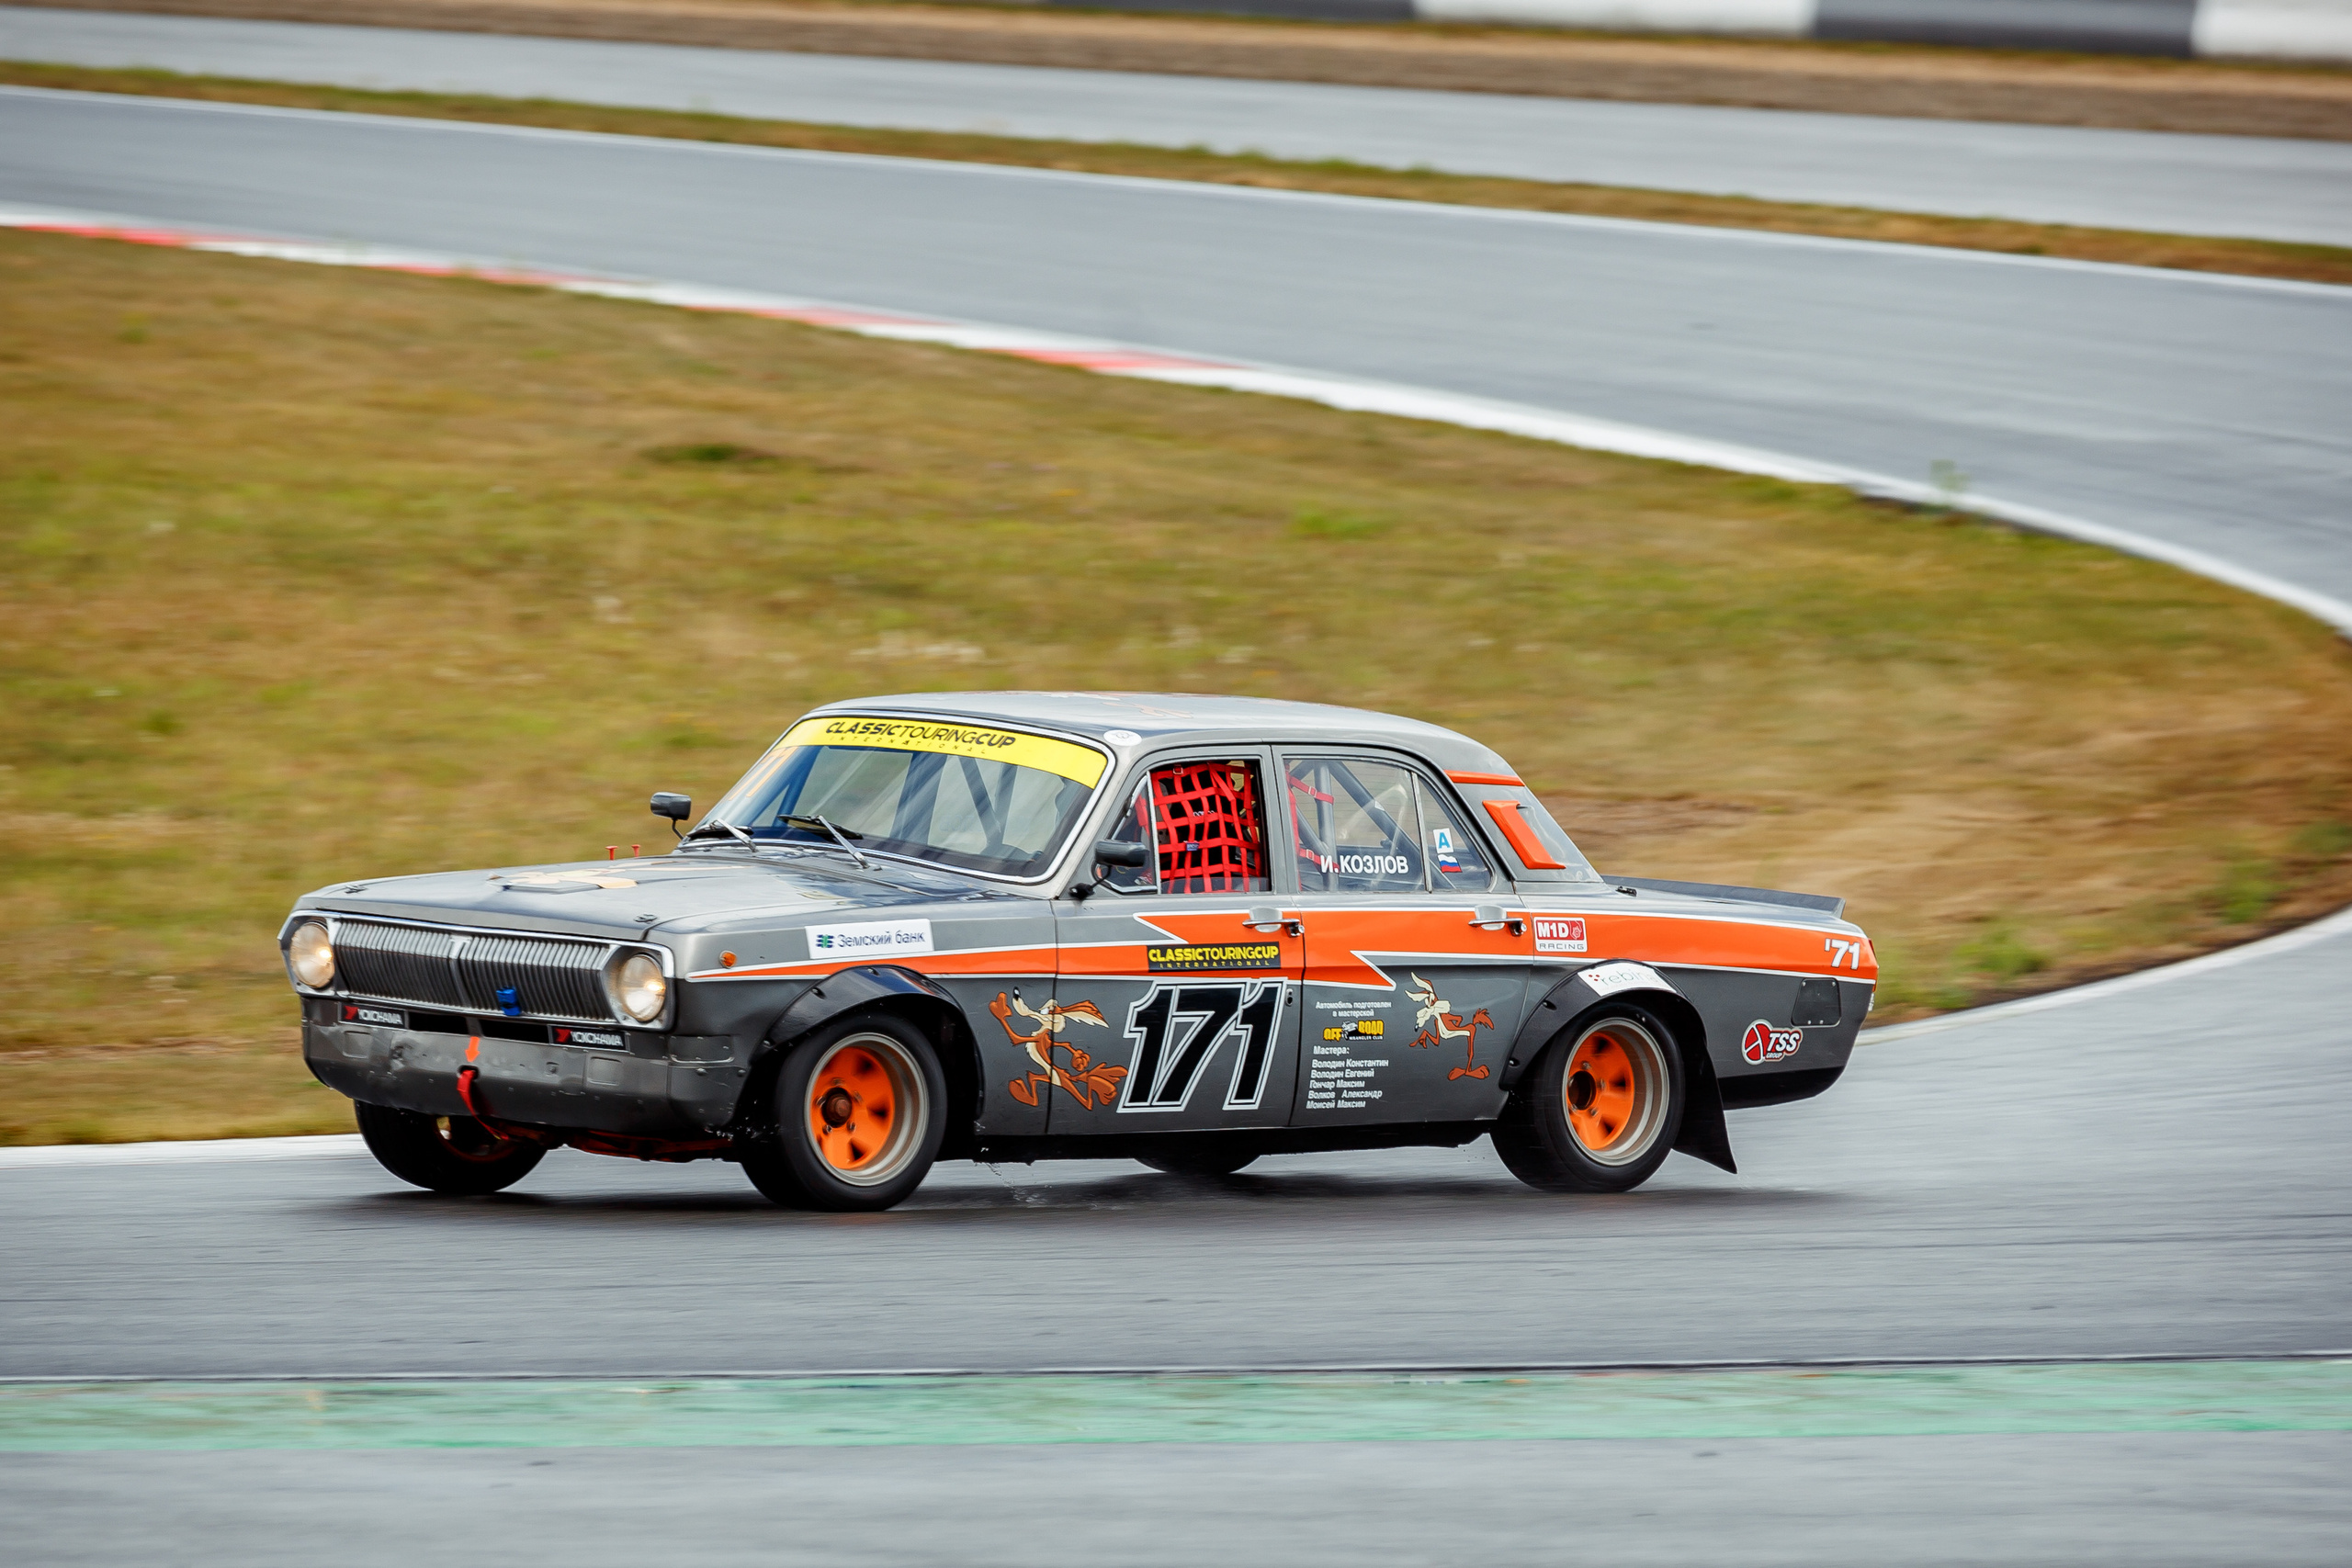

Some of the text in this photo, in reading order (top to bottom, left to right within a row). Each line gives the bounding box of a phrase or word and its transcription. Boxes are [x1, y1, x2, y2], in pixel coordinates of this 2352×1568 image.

[826, 721, 1016, 749] CLASSICTOURINGCUP
[829, 736, 987, 754] INTERNATIONAL
[1537, 921, 1569, 938] M1D
[837, 930, 925, 947] Земский банк
[1148, 945, 1279, 962] CLASSICTOURINGCUP
[1825, 938, 1860, 970] '71
[1159, 960, 1270, 968] INTERNATIONAL
[1353, 1001, 1392, 1010] подготовлен
[1338, 1010, 1374, 1018] мастерской
[571, 1031, 624, 1046] YOKOHAMA
[1323, 1020, 1384, 1042] OFF ROAD
[1116, 976, 1288, 1113] 171
[1767, 1032, 1800, 1052] TSS
[1313, 1045, 1350, 1055] Мастера:
[1311, 1058, 1389, 1068] Володин Константин
[1310, 1068, 1374, 1078] Володин Евгений
[1309, 1079, 1365, 1089] Гончар Максим
[1307, 1089, 1383, 1099] Волков Александр
[1306, 1100, 1366, 1110] Моисей Максим
